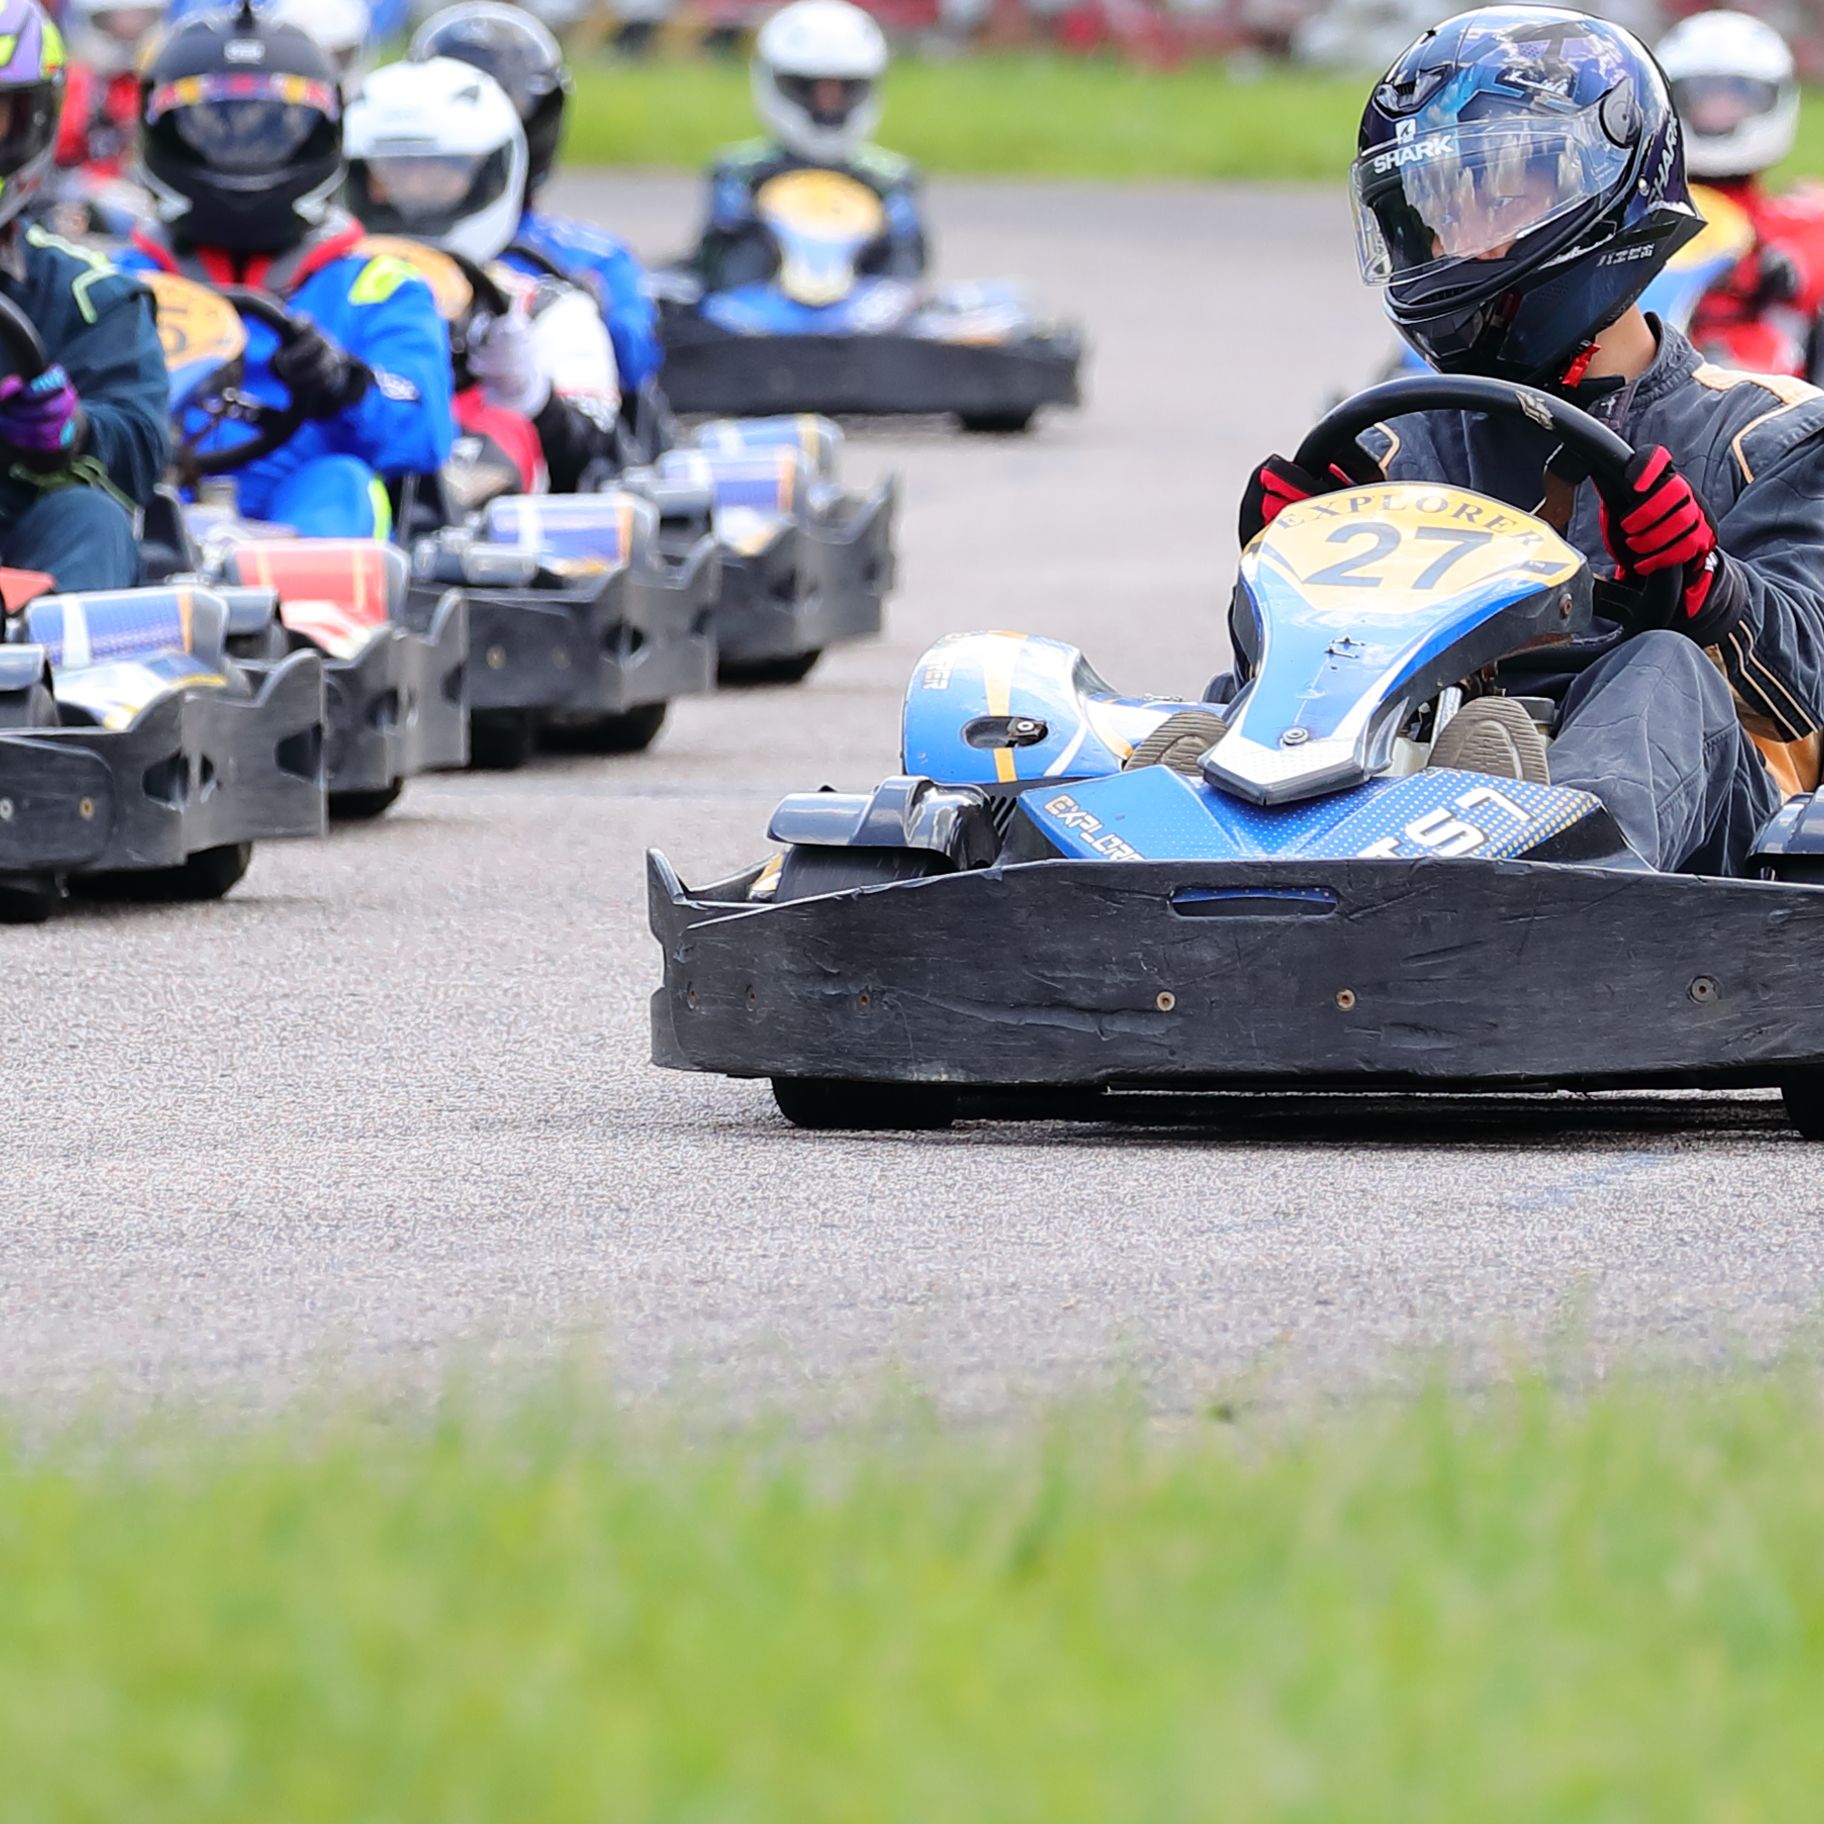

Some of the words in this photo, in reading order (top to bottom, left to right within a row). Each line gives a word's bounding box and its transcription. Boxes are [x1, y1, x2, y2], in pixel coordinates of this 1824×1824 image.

[1373, 134, 1454, 174] SHARK
[1276, 493, 1546, 547] EXPLORER
[1303, 521, 1494, 590] 27
